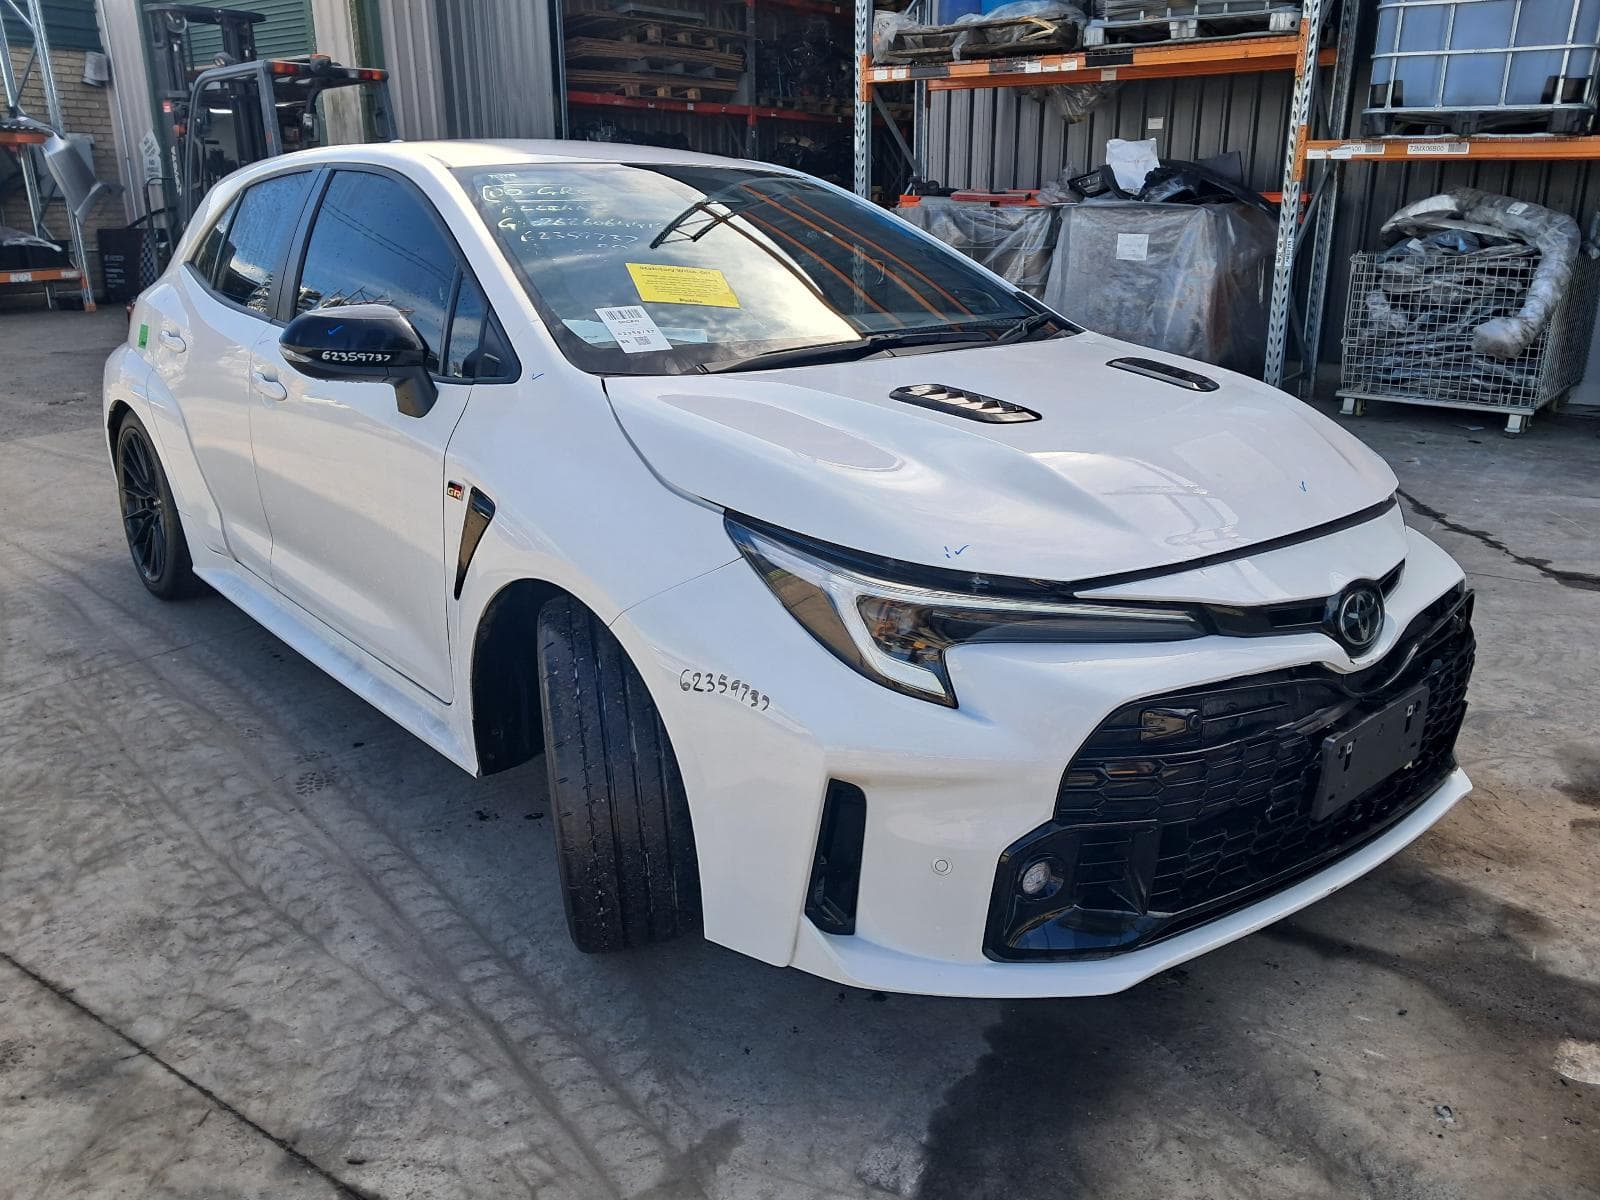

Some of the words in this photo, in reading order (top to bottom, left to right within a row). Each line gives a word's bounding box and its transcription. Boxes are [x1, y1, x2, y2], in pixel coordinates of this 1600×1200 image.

[321, 350, 391, 362] 62359737
[447, 487, 461, 500] GR
[679, 668, 770, 711] 62359737
